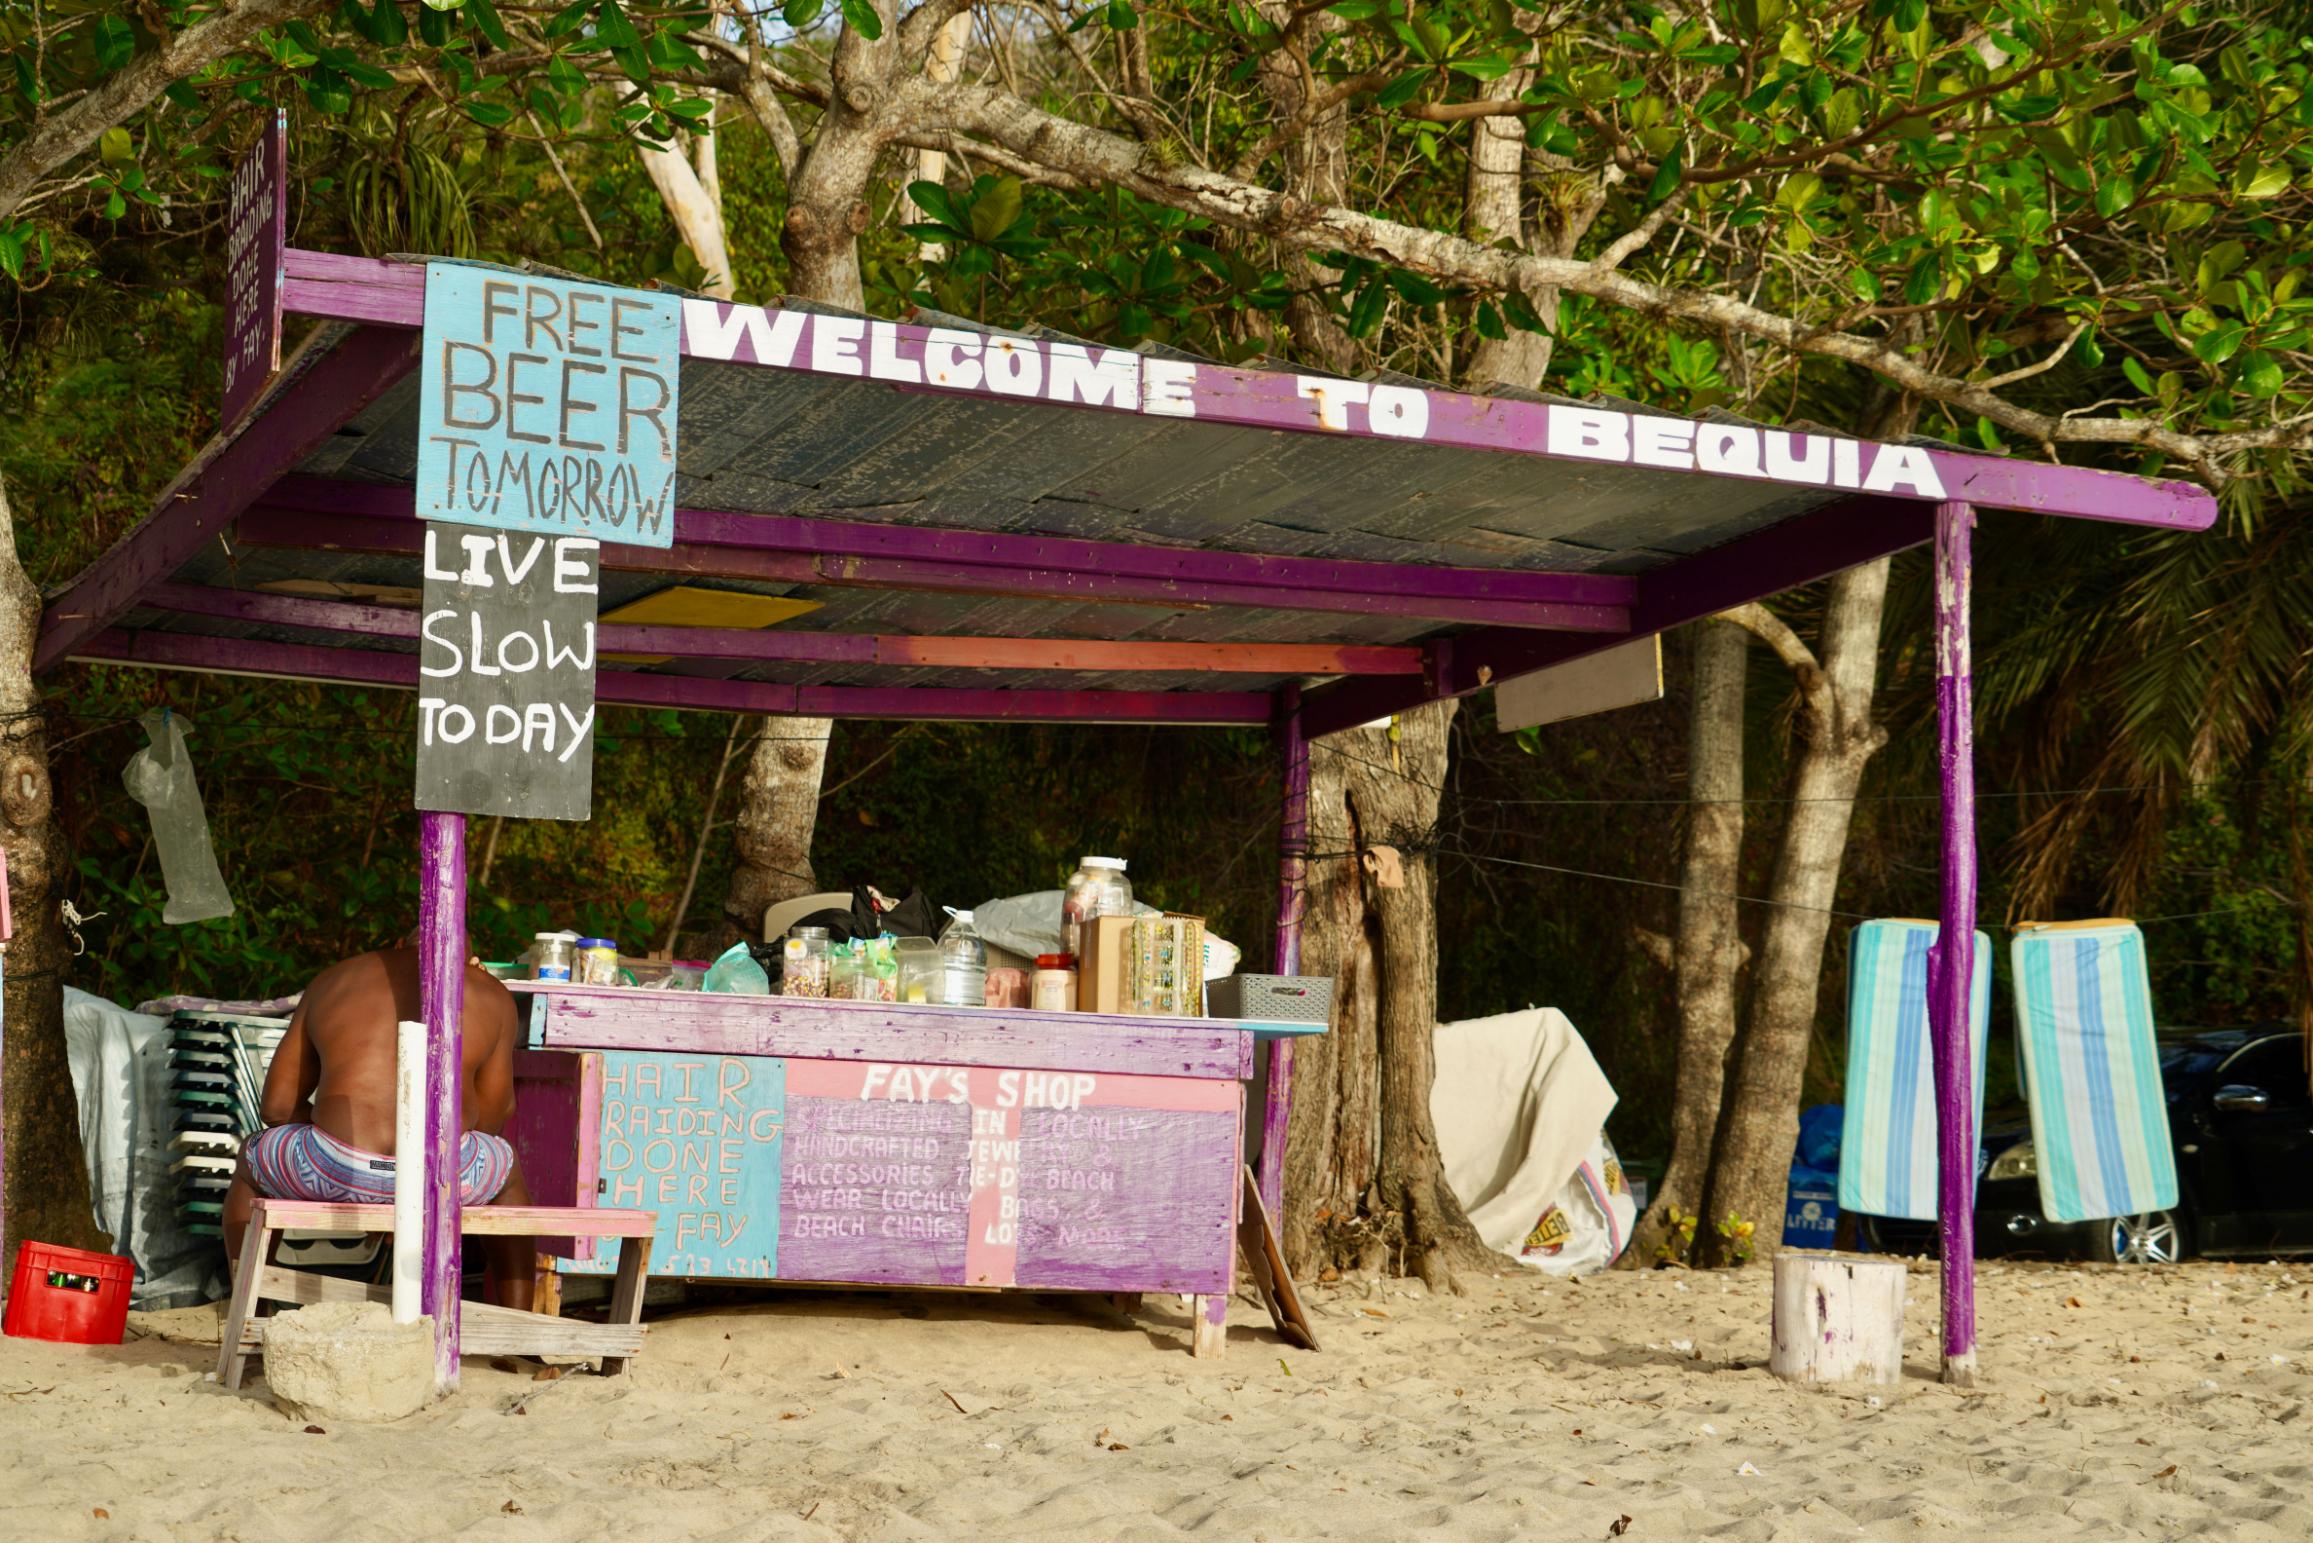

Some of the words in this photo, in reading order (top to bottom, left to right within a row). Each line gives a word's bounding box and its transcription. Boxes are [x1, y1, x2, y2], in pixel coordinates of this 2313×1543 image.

[229, 137, 265, 229] HAIR
[227, 180, 273, 274] BRAIDING
[232, 241, 259, 302] DONE
[233, 278, 259, 338] HERE
[482, 281, 659, 364] FREE
[225, 351, 238, 393] BY
[442, 340, 671, 456] BEER
[681, 298, 1197, 417] WELCOME
[1297, 375, 1430, 438] TO
[1547, 404, 1948, 499] BEQUIA
[429, 435, 673, 536] TOMORROW
[424, 532, 599, 595] LIVE
[420, 608, 594, 677] SLOW
[602, 1058, 750, 1109] HAIR
[861, 1065, 969, 1105] FAY'S
[996, 1072, 1097, 1111] SHOP
[604, 1100, 785, 1143] RAIDING
[974, 1109, 1007, 1136] IN
[1038, 1112, 1146, 1142] LOCALLY
[606, 1138, 745, 1174] DONE
[795, 1135, 940, 1161] HANDCRAFTED
[967, 1139, 1071, 1165] JEWERY
[613, 1174, 739, 1208] HERE
[791, 1161, 935, 1186] ACCESSORIES
[1046, 1168, 1115, 1192] BEACH
[793, 1188, 862, 1210] WEAR
[882, 1189, 973, 1214] LOCALLY
[1786, 1213, 1837, 1231] LITTER
[676, 1212, 748, 1251] FAY
[794, 1214, 866, 1240] BEACH
